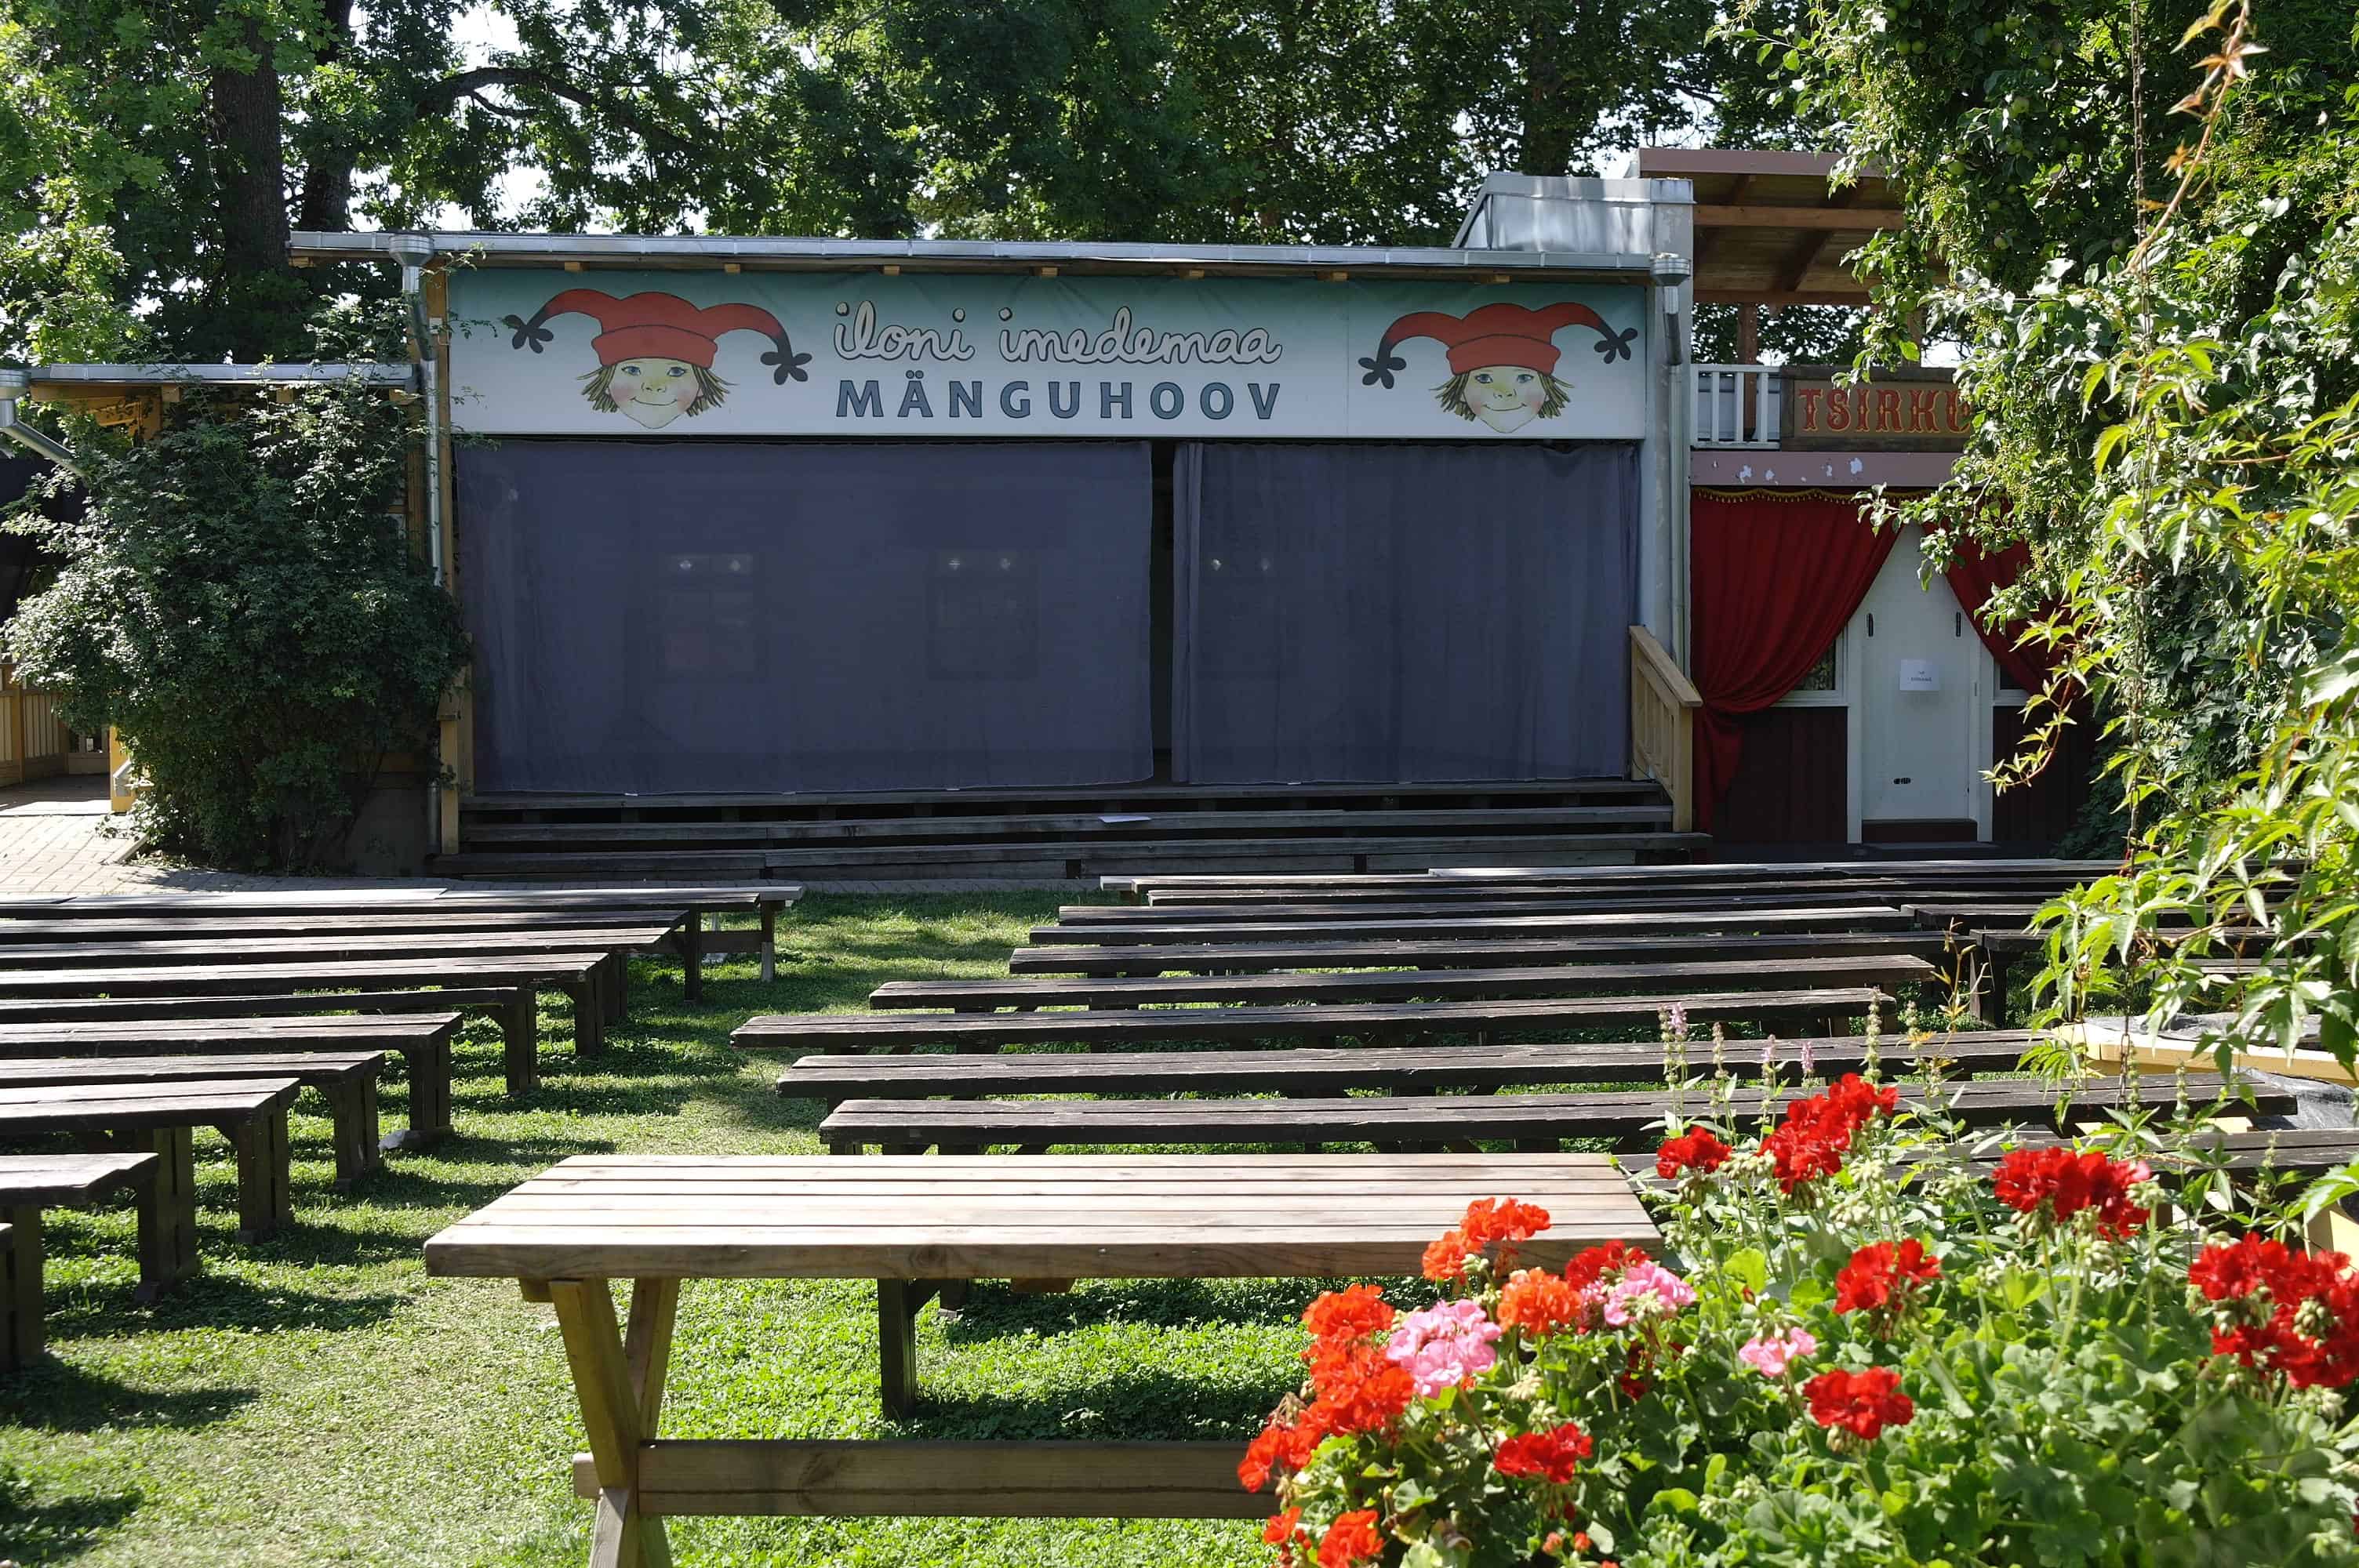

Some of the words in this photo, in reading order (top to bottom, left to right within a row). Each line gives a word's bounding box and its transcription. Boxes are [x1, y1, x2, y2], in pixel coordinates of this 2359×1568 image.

[834, 300, 975, 361] iloni
[998, 306, 1283, 365] imedemaa
[835, 370, 1281, 420] MÄNGUHOOV
